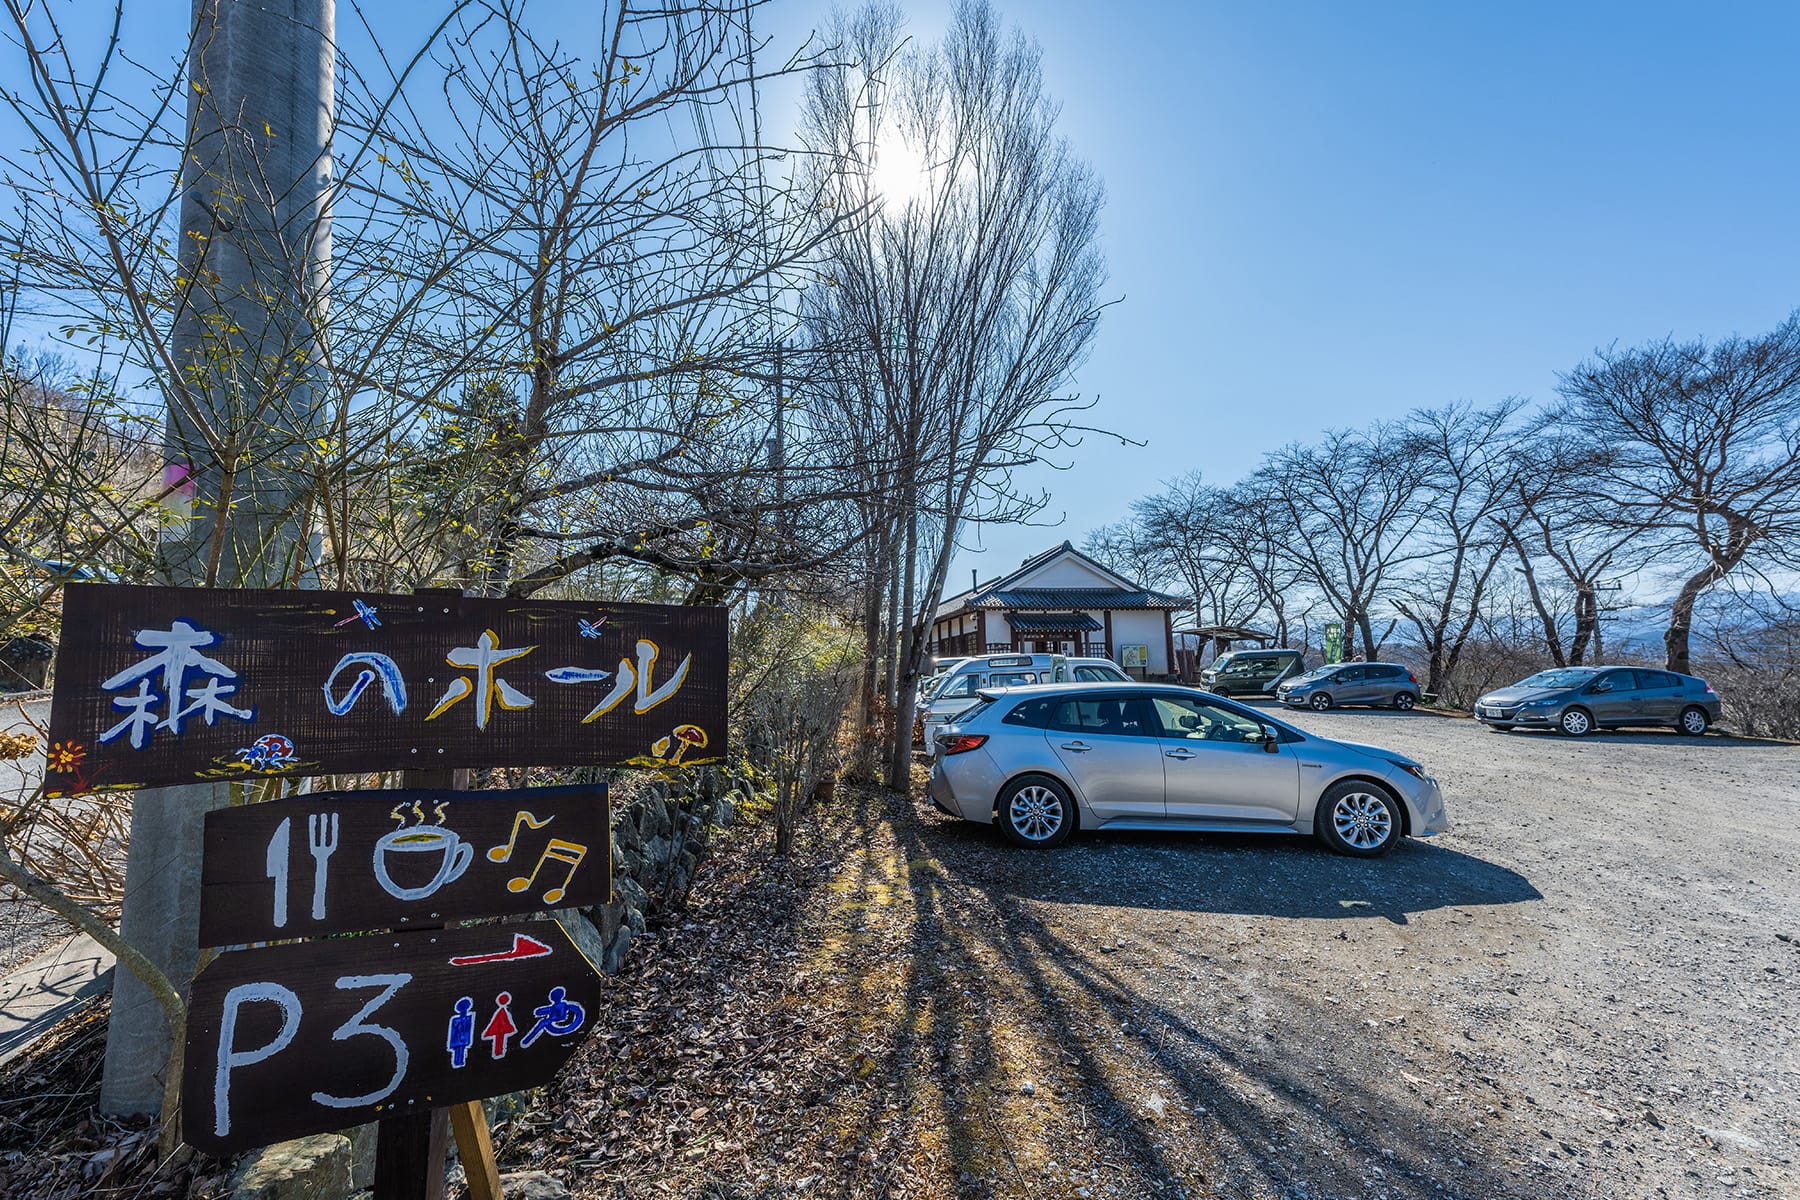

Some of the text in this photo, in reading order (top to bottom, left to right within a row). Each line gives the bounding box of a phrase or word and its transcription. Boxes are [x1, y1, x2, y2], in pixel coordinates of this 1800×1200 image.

[97, 616, 691, 750] 森のホール
